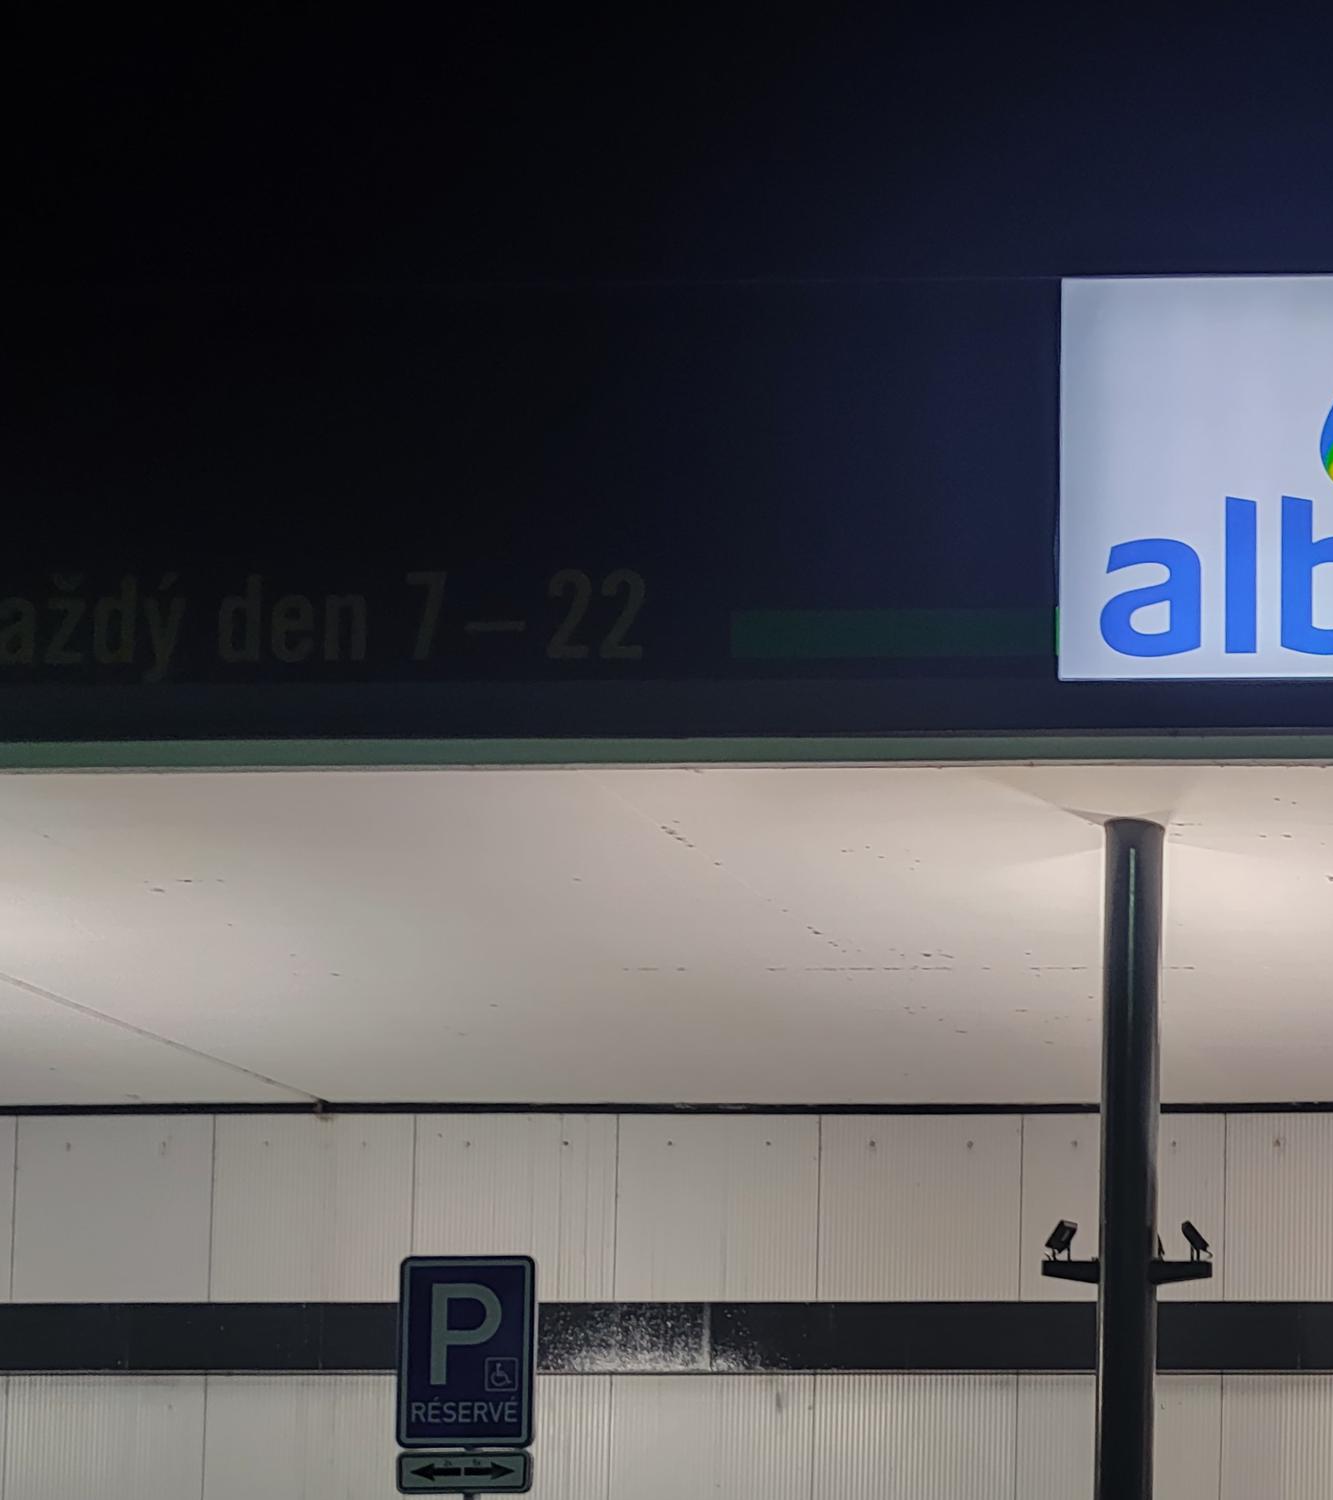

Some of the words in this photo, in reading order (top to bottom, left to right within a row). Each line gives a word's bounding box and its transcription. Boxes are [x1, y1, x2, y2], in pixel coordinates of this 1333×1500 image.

[218, 573, 367, 663] den
[429, 1282, 503, 1386] P
[410, 1396, 519, 1423] RÉSERVÉ
